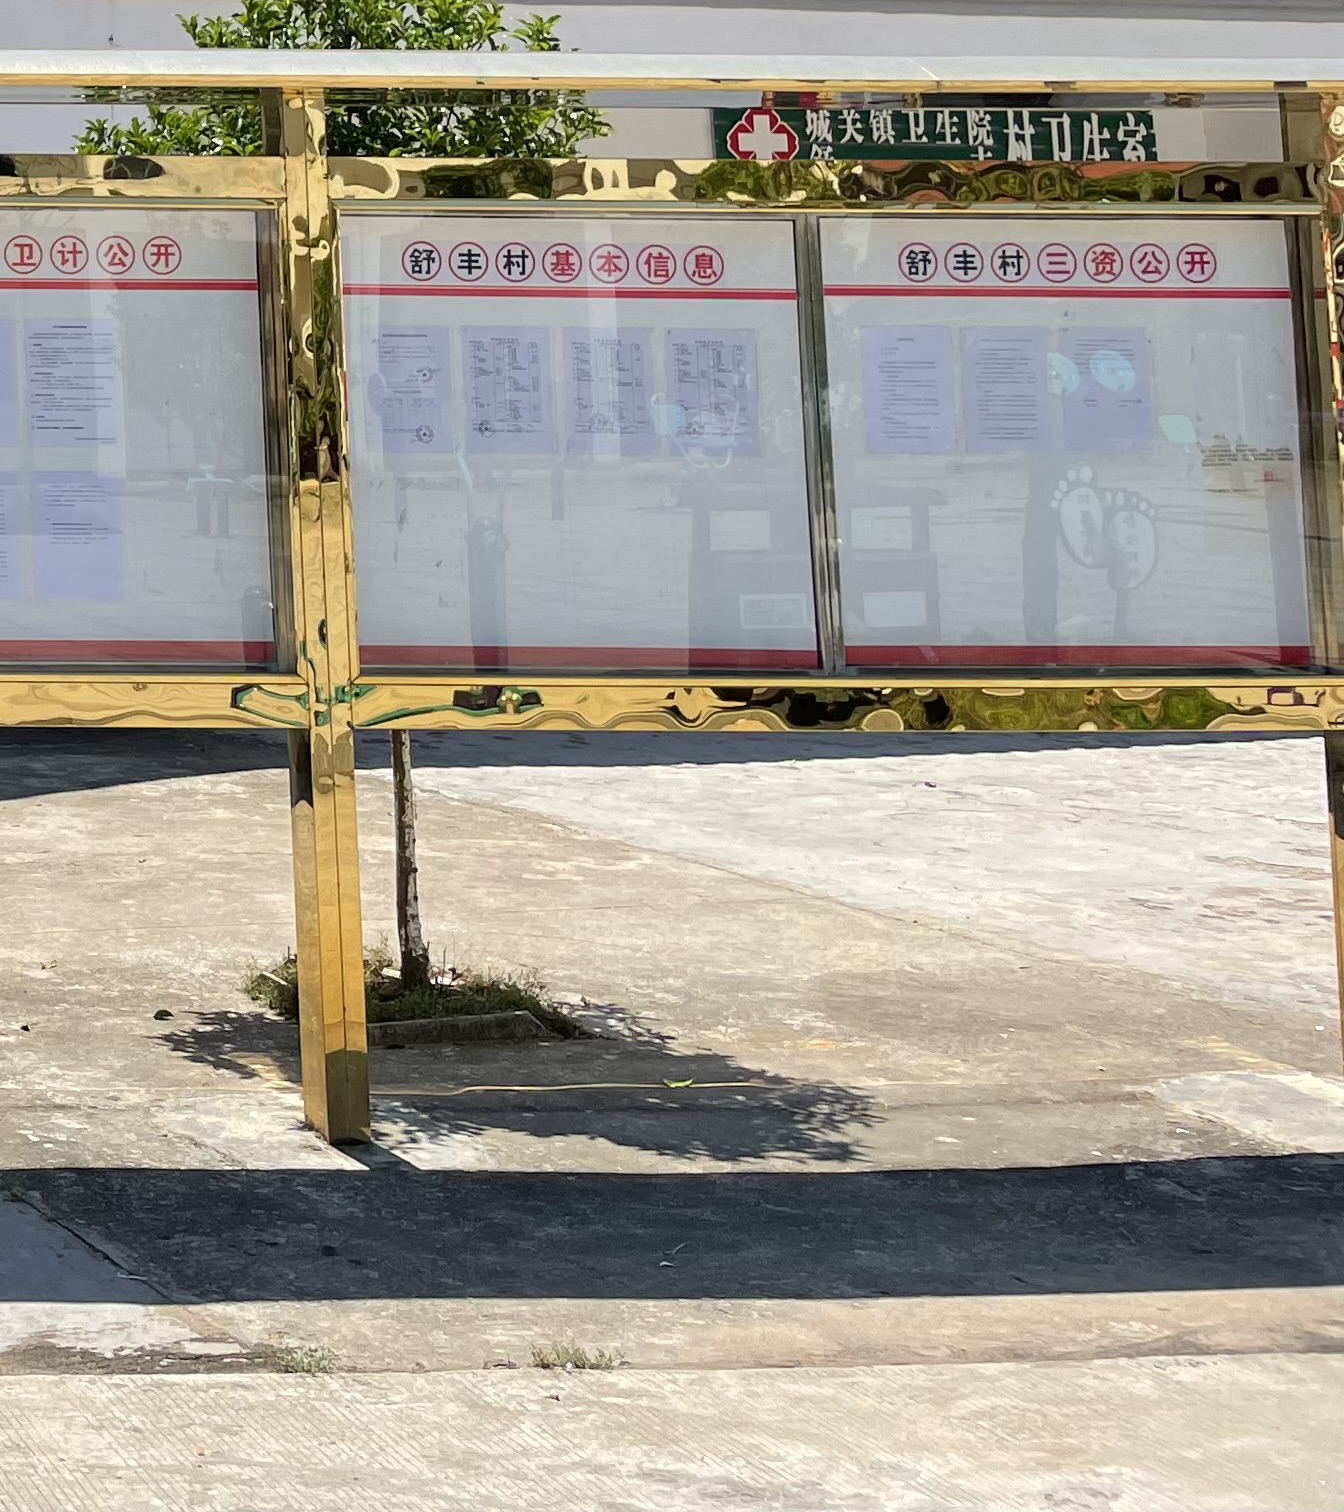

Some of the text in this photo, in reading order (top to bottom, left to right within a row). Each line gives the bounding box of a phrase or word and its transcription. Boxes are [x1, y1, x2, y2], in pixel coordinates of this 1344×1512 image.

[805, 108, 995, 146] 城关镇卫生院
[1006, 108, 1150, 162] 村卫生室
[407, 246, 720, 280] 舒丰村基本信息
[904, 248, 1211, 278] 舒丰村三资公开
